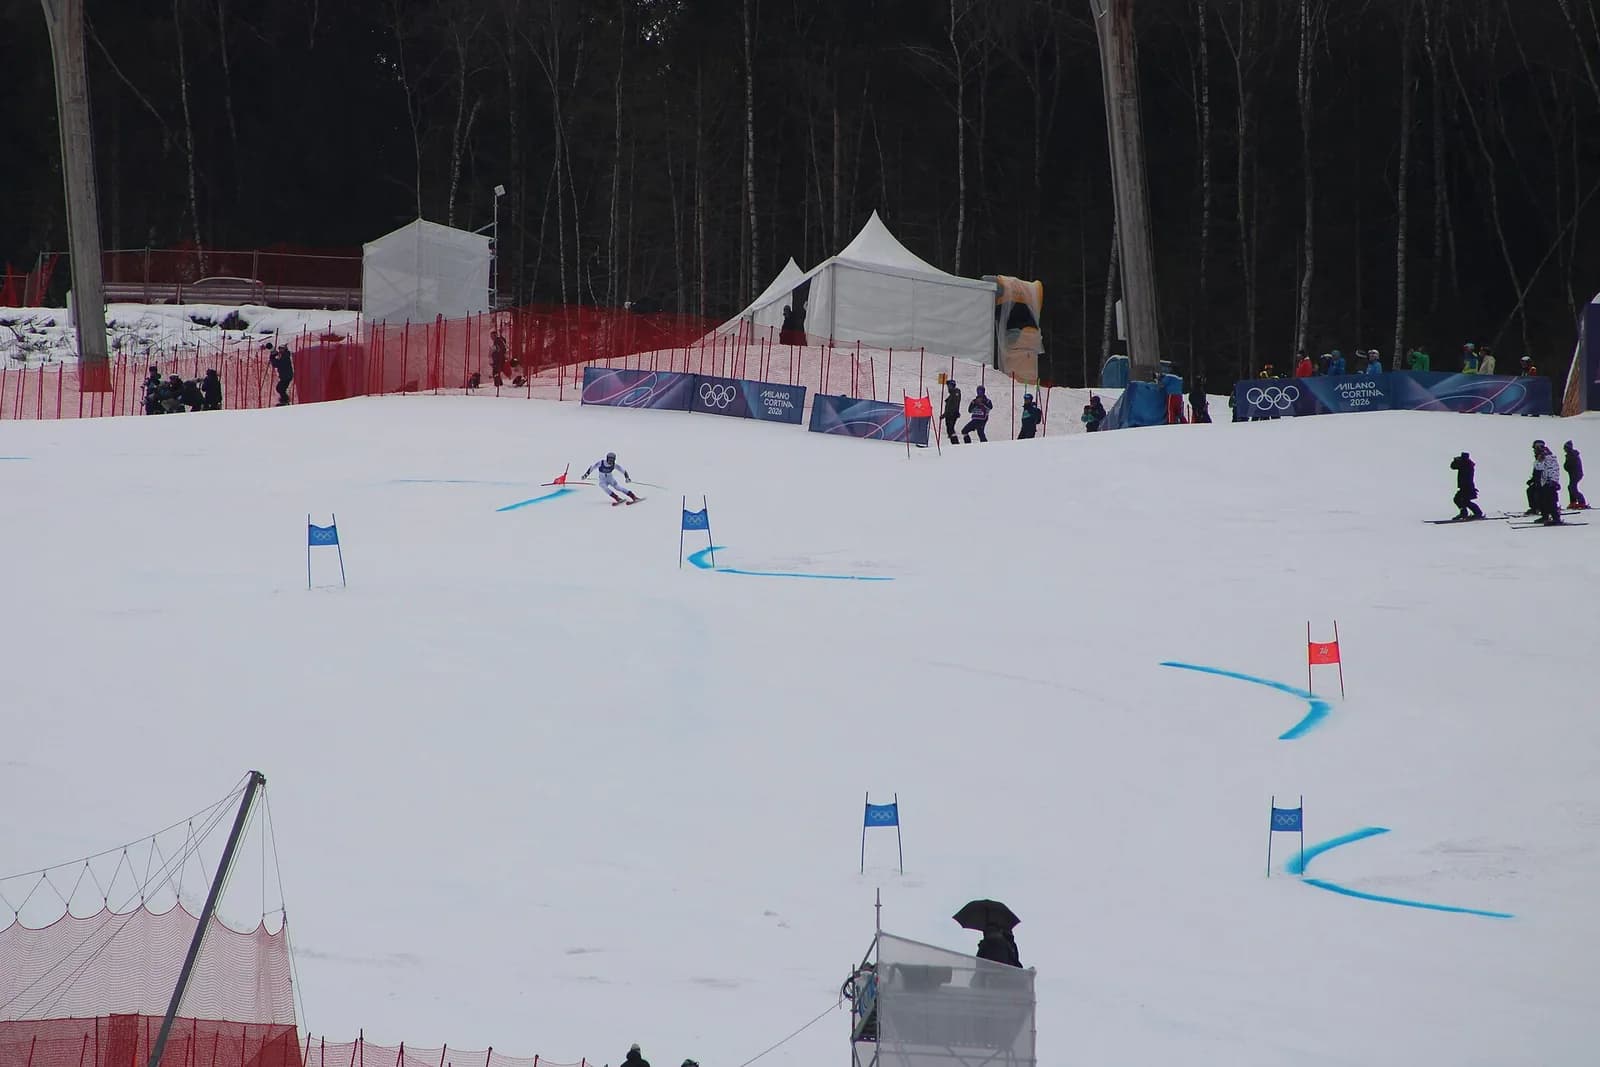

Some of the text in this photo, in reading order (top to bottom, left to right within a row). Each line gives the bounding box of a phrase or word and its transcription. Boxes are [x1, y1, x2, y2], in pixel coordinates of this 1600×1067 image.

[1334, 381, 1376, 391] MILANO
[760, 390, 790, 400] MILANO
[1341, 389, 1384, 398] CORTINA
[764, 398, 794, 408] CORTINA
[1350, 398, 1370, 406] 2026
[768, 407, 782, 415] 2026
